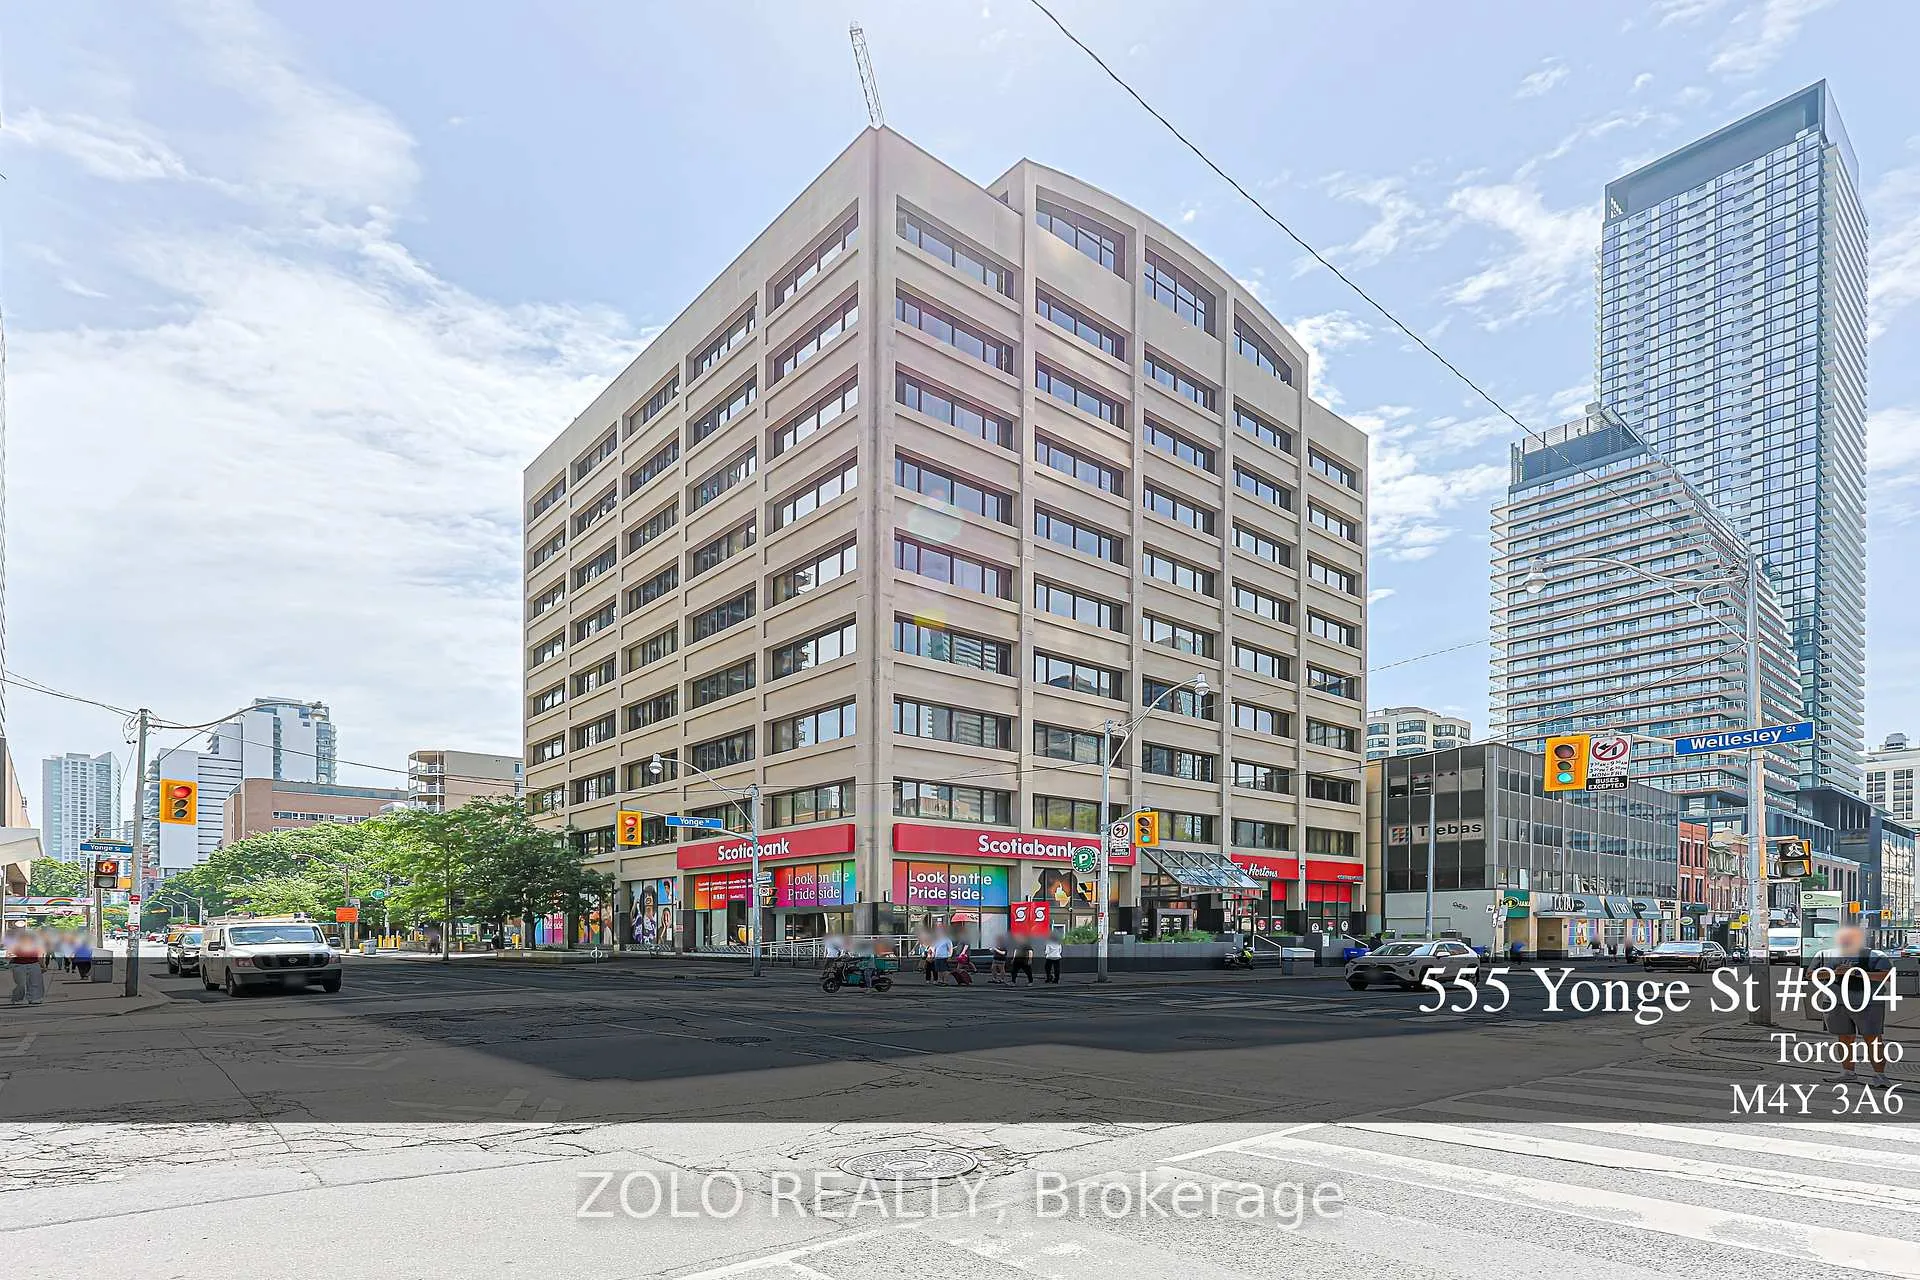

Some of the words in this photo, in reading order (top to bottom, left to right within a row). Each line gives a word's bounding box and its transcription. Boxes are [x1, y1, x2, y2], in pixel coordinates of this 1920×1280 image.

[1690, 729, 1782, 750] Wellesley
[1785, 725, 1797, 734] St
[1588, 782, 1625, 790] EXCEPTED
[680, 817, 704, 827] Yonge
[1417, 823, 1482, 837] Tebas
[90, 844, 113, 852] Yonge
[717, 837, 790, 861] Scotiabank
[977, 834, 1076, 859] Scotiabank
[1078, 853, 1089, 864] P
[787, 872, 814, 886] Look
[817, 873, 830, 884] on
[832, 869, 850, 883] the
[908, 869, 946, 885] Look
[949, 874, 967, 885] on
[968, 872, 993, 886] the
[1249, 862, 1278, 878] Hortons
[787, 887, 816, 901] Pride
[908, 885, 947, 899] Pride
[950, 886, 985, 900] side.
